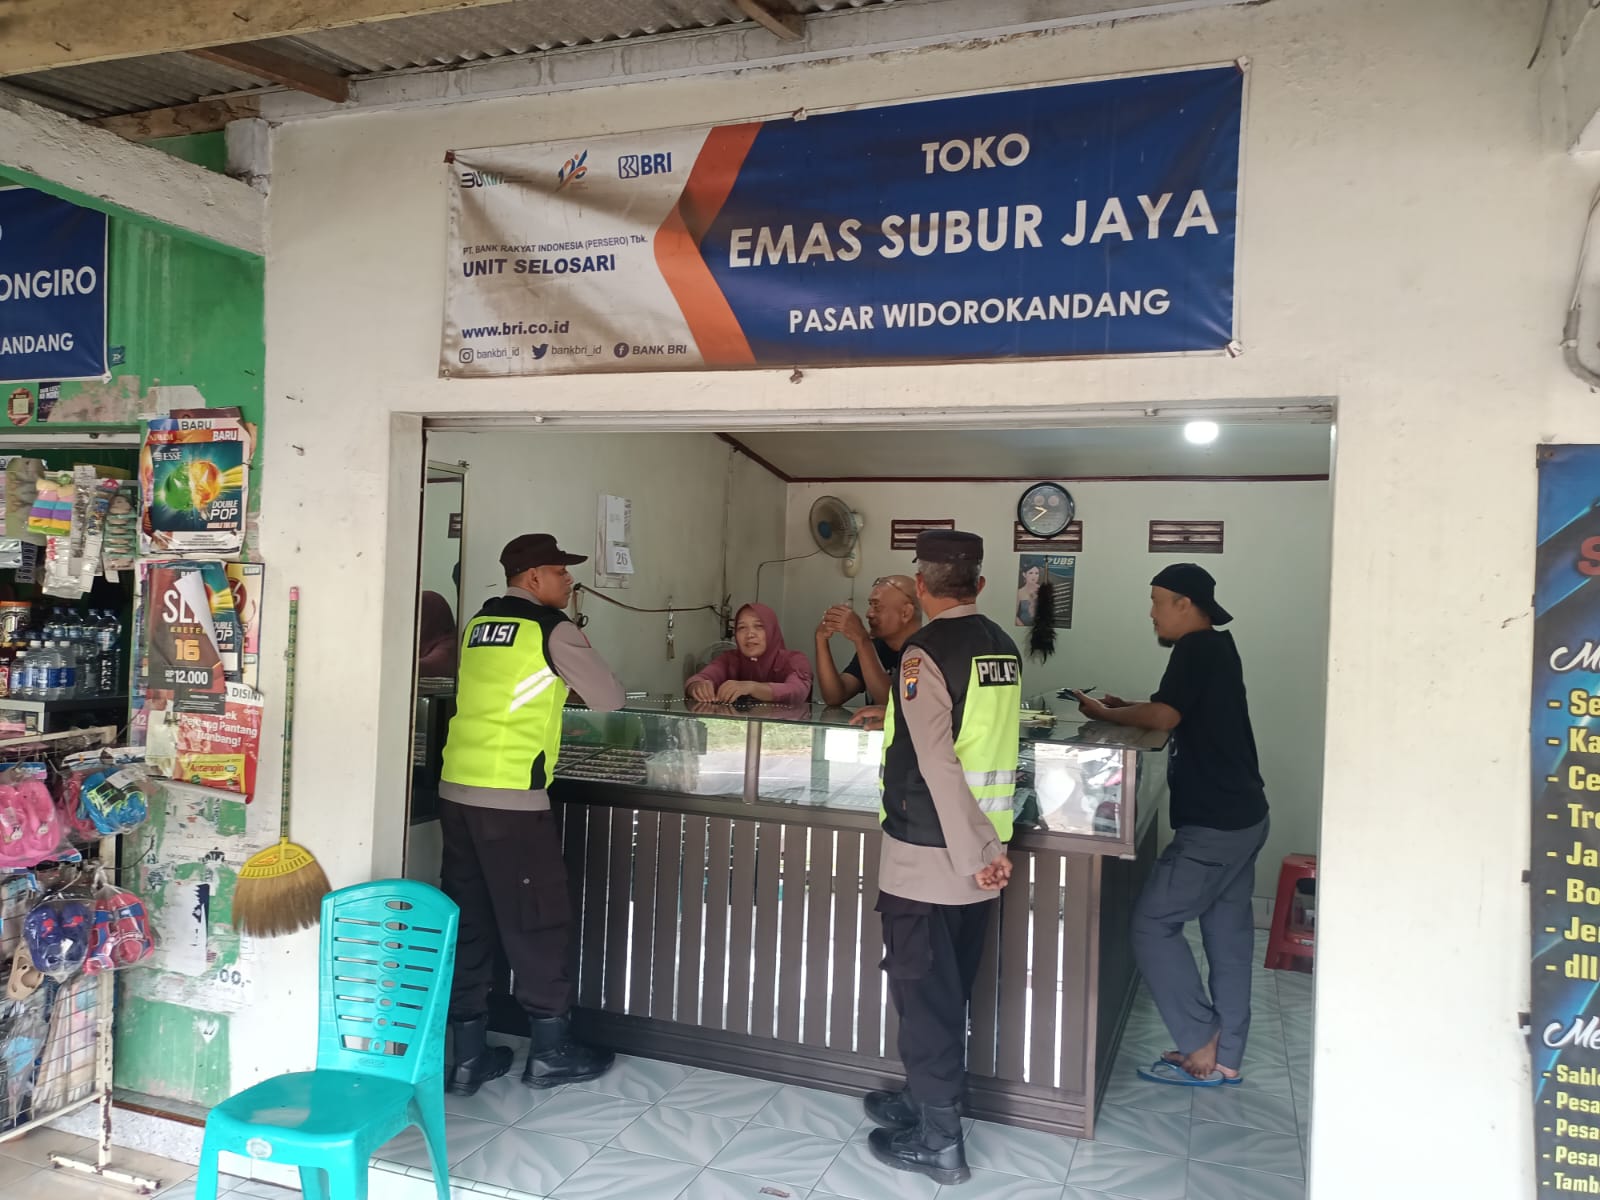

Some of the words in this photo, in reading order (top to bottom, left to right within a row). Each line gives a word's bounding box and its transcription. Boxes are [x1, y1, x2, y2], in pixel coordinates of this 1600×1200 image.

[922, 132, 1030, 175] TOKO
[641, 152, 672, 176] BRI
[729, 218, 862, 268] EMAS
[878, 204, 1043, 259] SUBUR
[1061, 189, 1219, 247] JAYA
[475, 245, 498, 254] BANK
[501, 245, 536, 254] RAKYAT
[538, 243, 584, 252] INDONESIA
[585, 236, 629, 250] (PERSERO)
[630, 234, 648, 244] Tbk.
[463, 259, 507, 278] UNIT
[514, 254, 615, 274] SELOSARI
[789, 304, 875, 334] PASAR
[882, 288, 1171, 329] WIDOROKANDANG
[462, 320, 570, 339] www.bri.co.id
[0, 332, 74, 355] ANDANG
[477, 347, 520, 359] bankbri_id
[551, 345, 602, 357] bankbri_id
[632, 345, 664, 355] BANK
[667, 345, 687, 355] BRI
[182, 420, 212, 430] BARU
[213, 430, 237, 441] BARU
[163, 452, 182, 461] ESSE
[212, 500, 238, 508] DOUBLE
[210, 509, 237, 520] POP
[615, 552, 629, 565] 26
[1053, 557, 1074, 566] UBS
[162, 590, 200, 623] SL
[175, 639, 200, 661] 16
[175, 670, 208, 685] 12.000
[232, 688, 261, 701] DISINI
[219, 721, 257, 738] Pantang
[1566, 841, 1600, 867] Ja
[1564, 916, 1600, 943] Je
[1565, 954, 1598, 981] dll
[214, 969, 251, 987] 00,-
[1555, 1145, 1600, 1167] Pesa
[1554, 1172, 1600, 1195] Tamb
